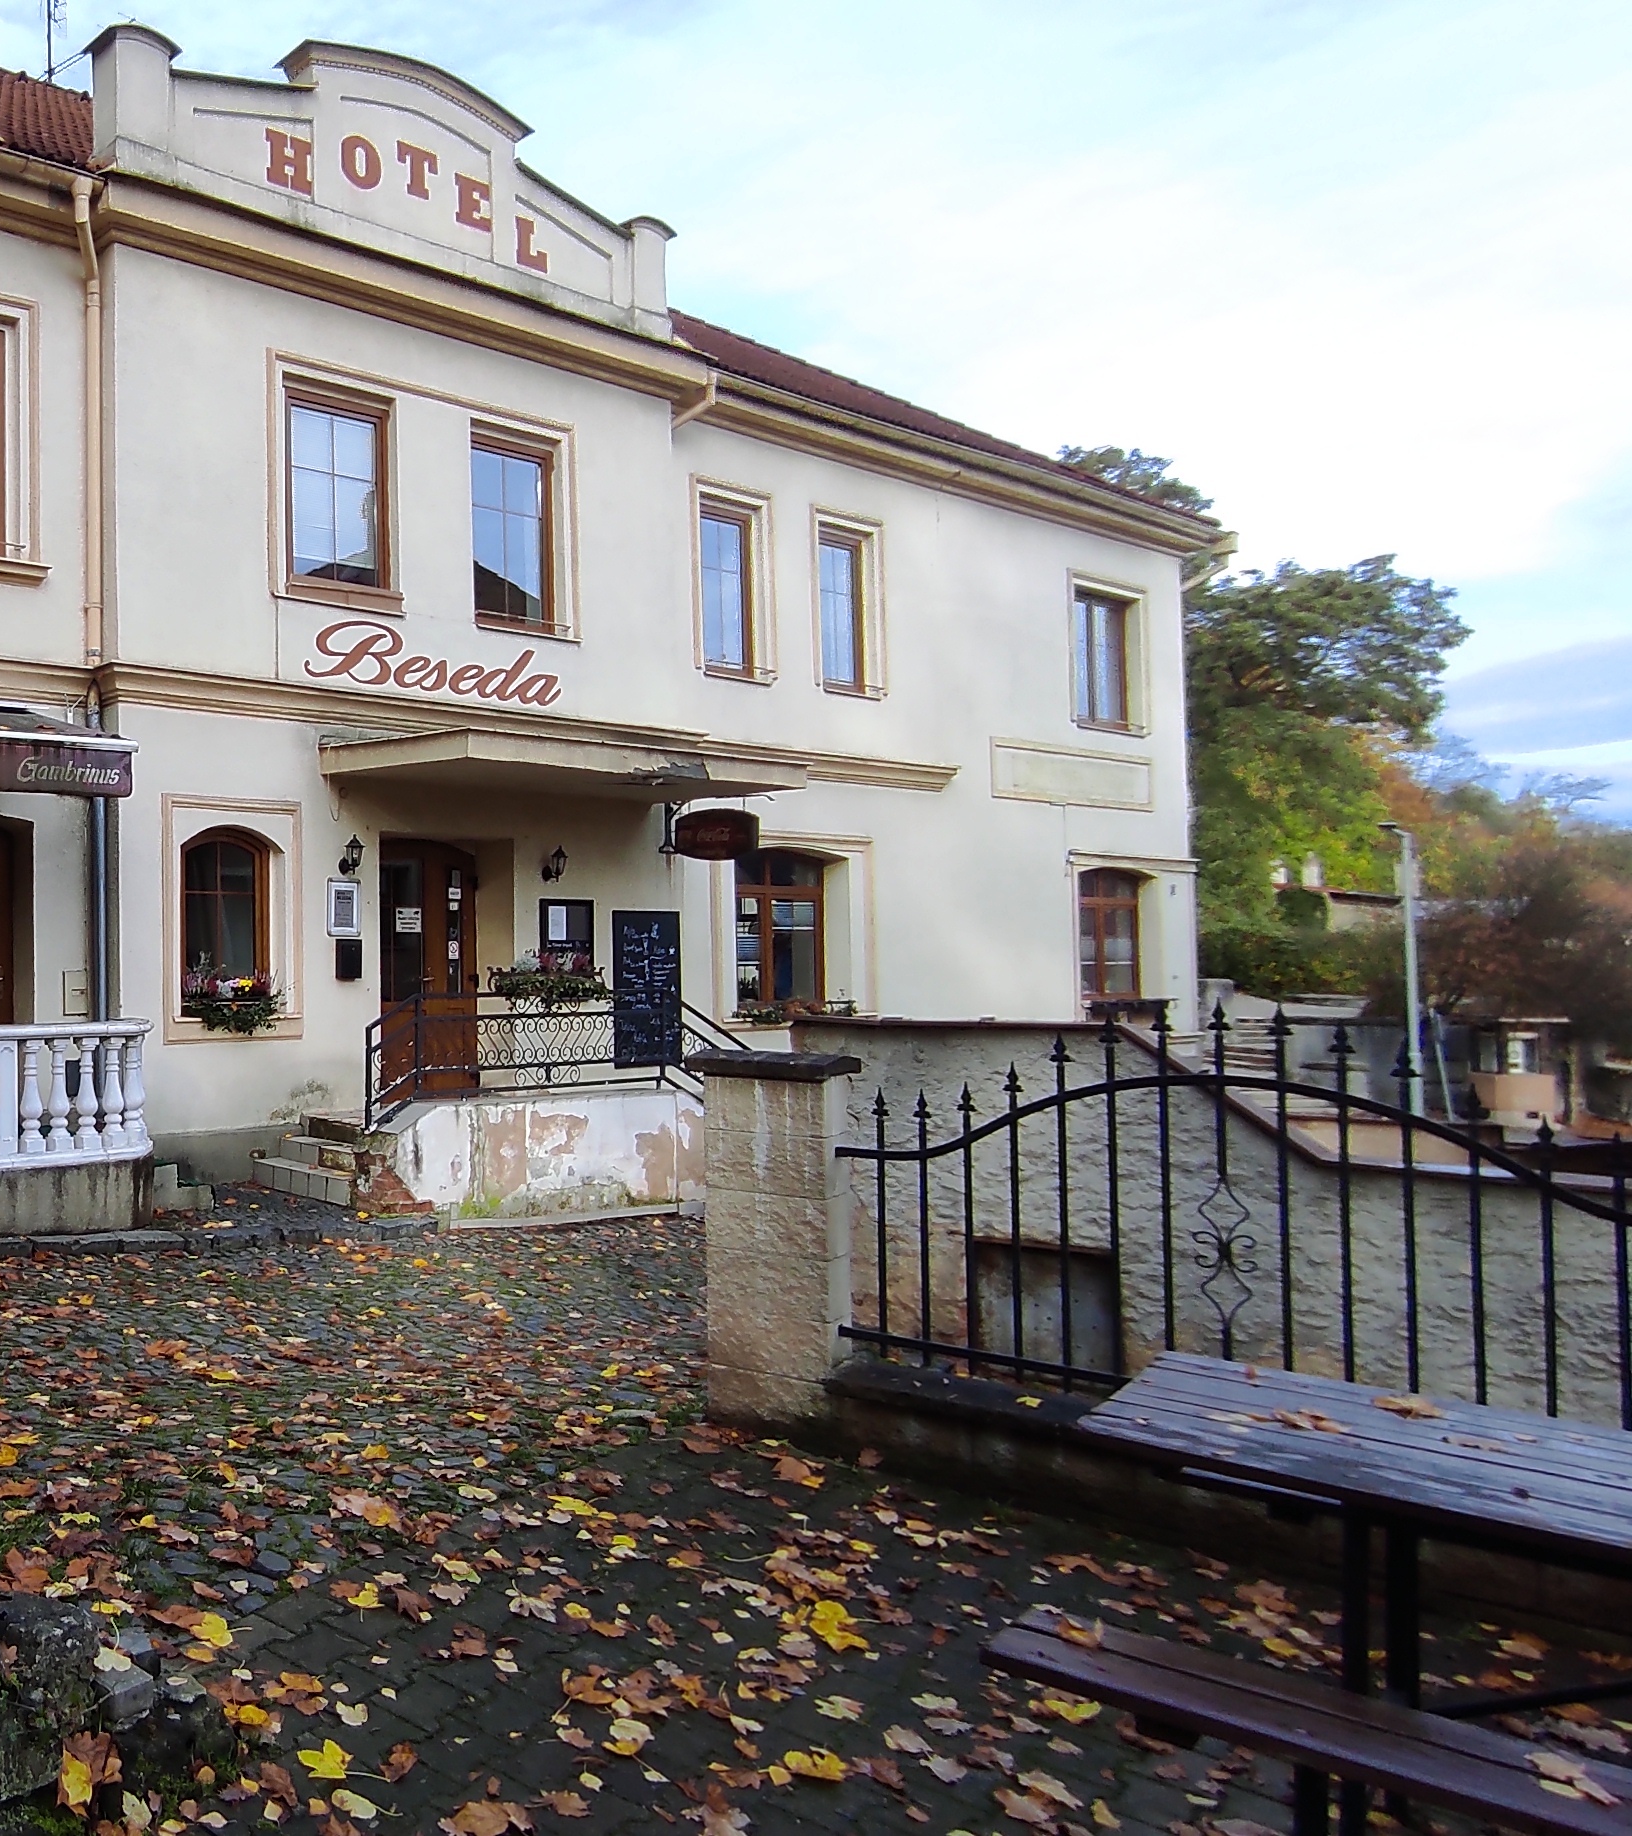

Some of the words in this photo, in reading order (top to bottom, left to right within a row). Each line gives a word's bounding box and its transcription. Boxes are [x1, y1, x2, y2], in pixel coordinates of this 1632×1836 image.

[266, 127, 548, 274] HOTEL
[303, 620, 562, 707] Beseda
[16, 757, 121, 786] Gambrinus
